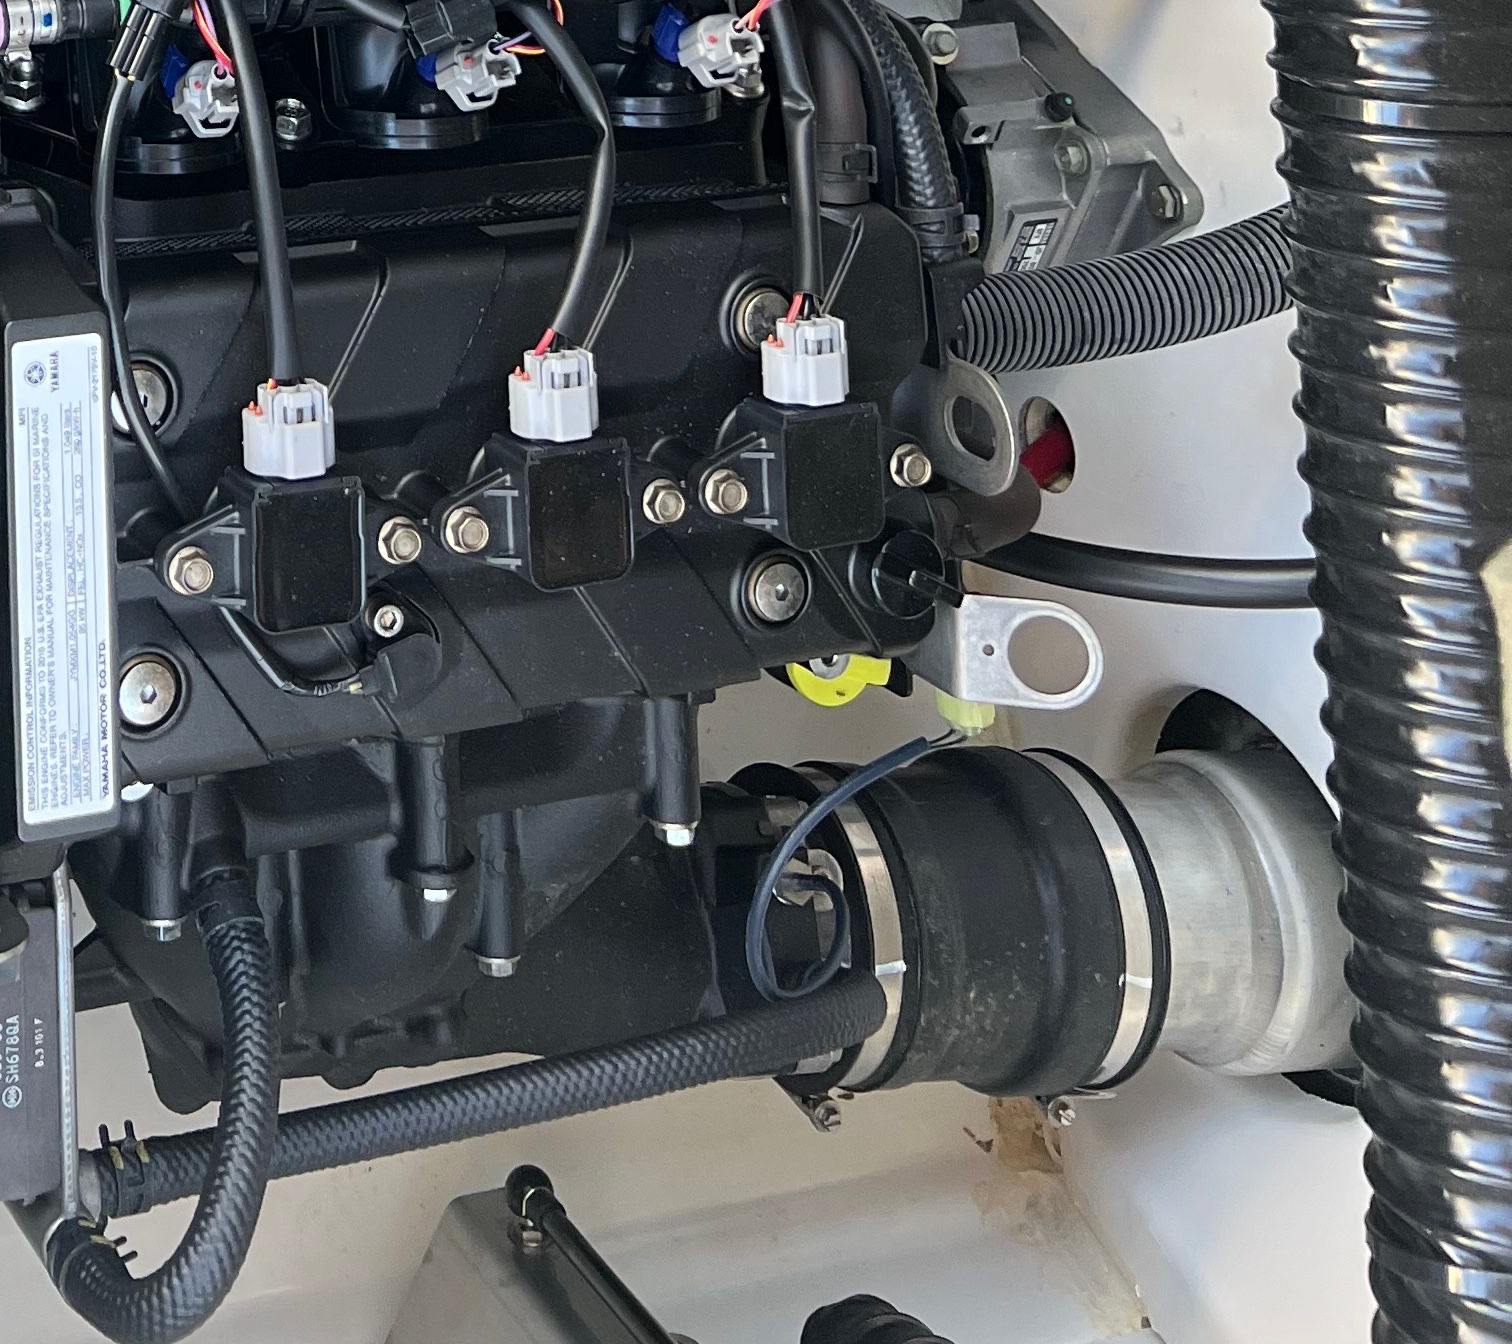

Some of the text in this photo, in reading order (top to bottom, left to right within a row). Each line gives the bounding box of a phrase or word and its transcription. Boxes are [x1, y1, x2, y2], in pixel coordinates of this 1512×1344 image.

[49, 350, 59, 391] YAMAHA
[31, 407, 39, 444] MARINE
[41, 413, 49, 434] AND
[32, 460, 40, 480] FOR
[41, 436, 51, 517] SPECIFICATIONS
[33, 483, 42, 552] REGULATIONS
[43, 520, 53, 591] MAINTENANCE
[35, 555, 43, 600] EXHAUST
[36, 603, 44, 622] EPA
[45, 594, 53, 614] FOR
[46, 617, 54, 657] MANUAL
[38, 670, 45, 682] TO
[47, 660, 55, 706] OWNER'S
[23, 636, 35, 811] EMISSION CONTROL INFORMATION
[38, 686, 47, 743] CONFORMS
[48, 709, 56, 721] TO
[99, 694, 107, 739] MOTOR
[48, 724, 57, 758] REFER
[39, 747, 48, 783] ENGINE
[100, 744, 109, 797] YAMAHA
[40, 786, 48, 809] THIS
[82, 775, 90, 796] MAX
